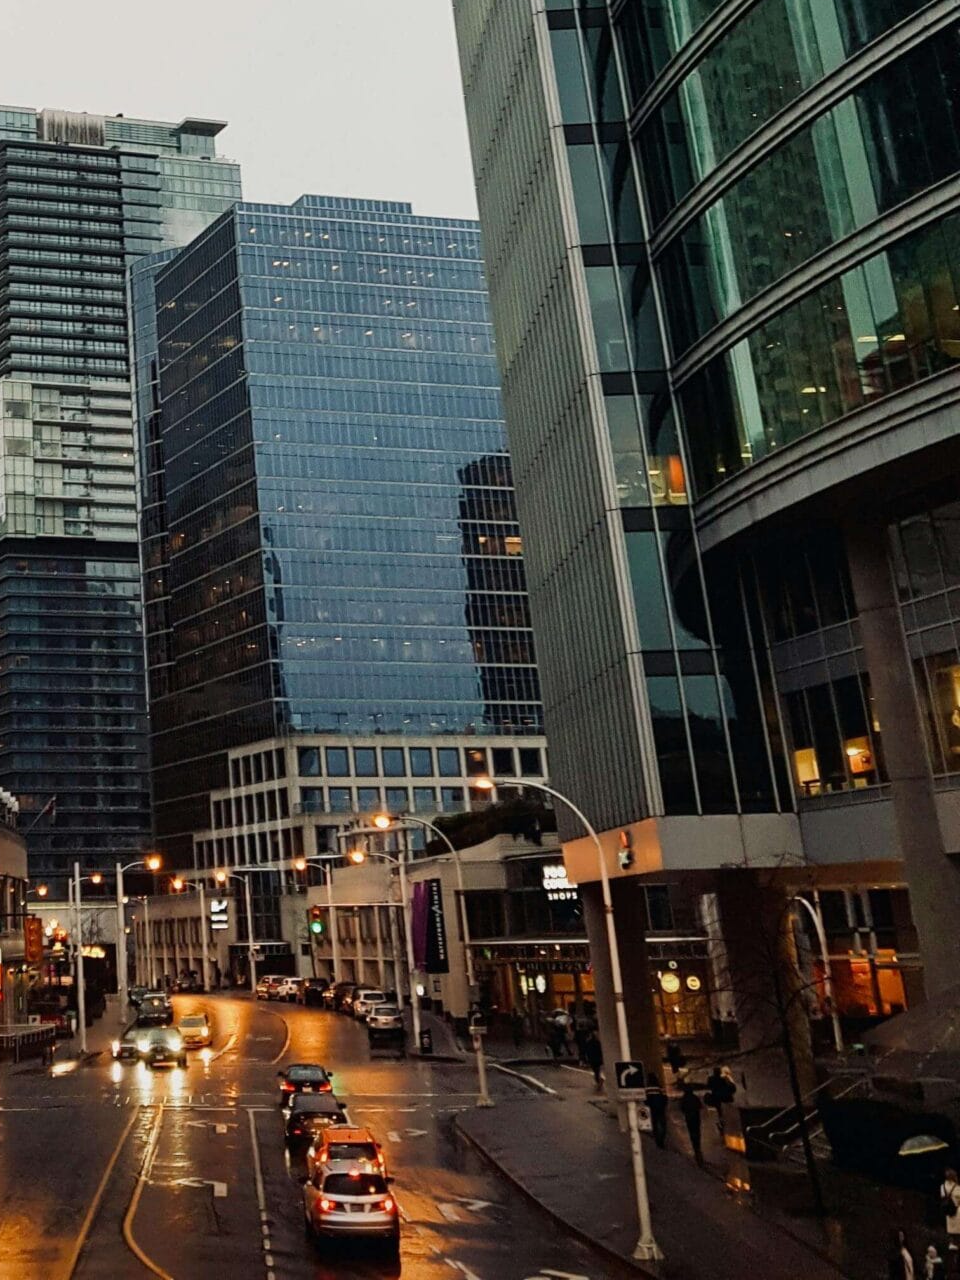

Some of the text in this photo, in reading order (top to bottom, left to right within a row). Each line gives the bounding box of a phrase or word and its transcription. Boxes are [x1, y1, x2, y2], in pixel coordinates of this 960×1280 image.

[543, 866, 567, 878] FOO
[548, 892, 578, 900] SHOPS
[434, 913, 445, 960] WATERFRONT
